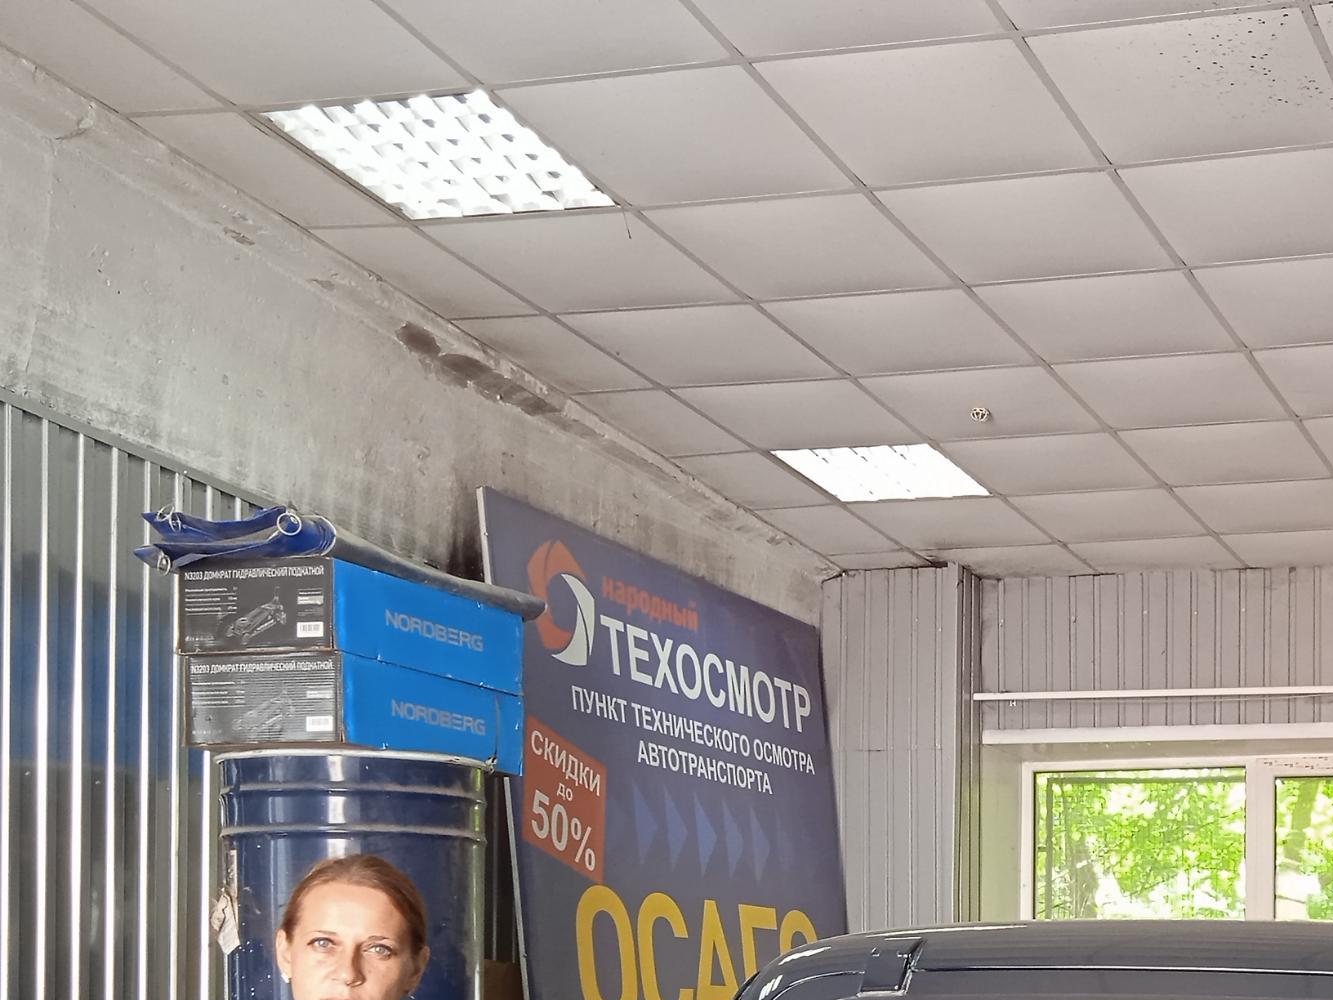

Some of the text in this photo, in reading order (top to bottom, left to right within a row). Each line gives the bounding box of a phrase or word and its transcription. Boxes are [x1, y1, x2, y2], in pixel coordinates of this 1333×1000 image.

[203, 570, 232, 580] ДОМКРАТ
[232, 566, 287, 579] ГИДРАВЛИЧЕСКИЙ
[289, 565, 325, 577] ПОДКАТНОЙ
[385, 609, 484, 652] NORDBERG
[603, 576, 698, 632] народный
[600, 614, 811, 733] ТЕХОСМОТР
[391, 698, 486, 736] NORDBERG
[571, 685, 815, 775] ПУНКТ ТЕХНИЧЕСКОГО ОСМОТРА
[531, 730, 601, 797] СКИДКИ
[638, 741, 773, 795] АВТОТРАНСПОРТА
[532, 789, 596, 872] 50%
